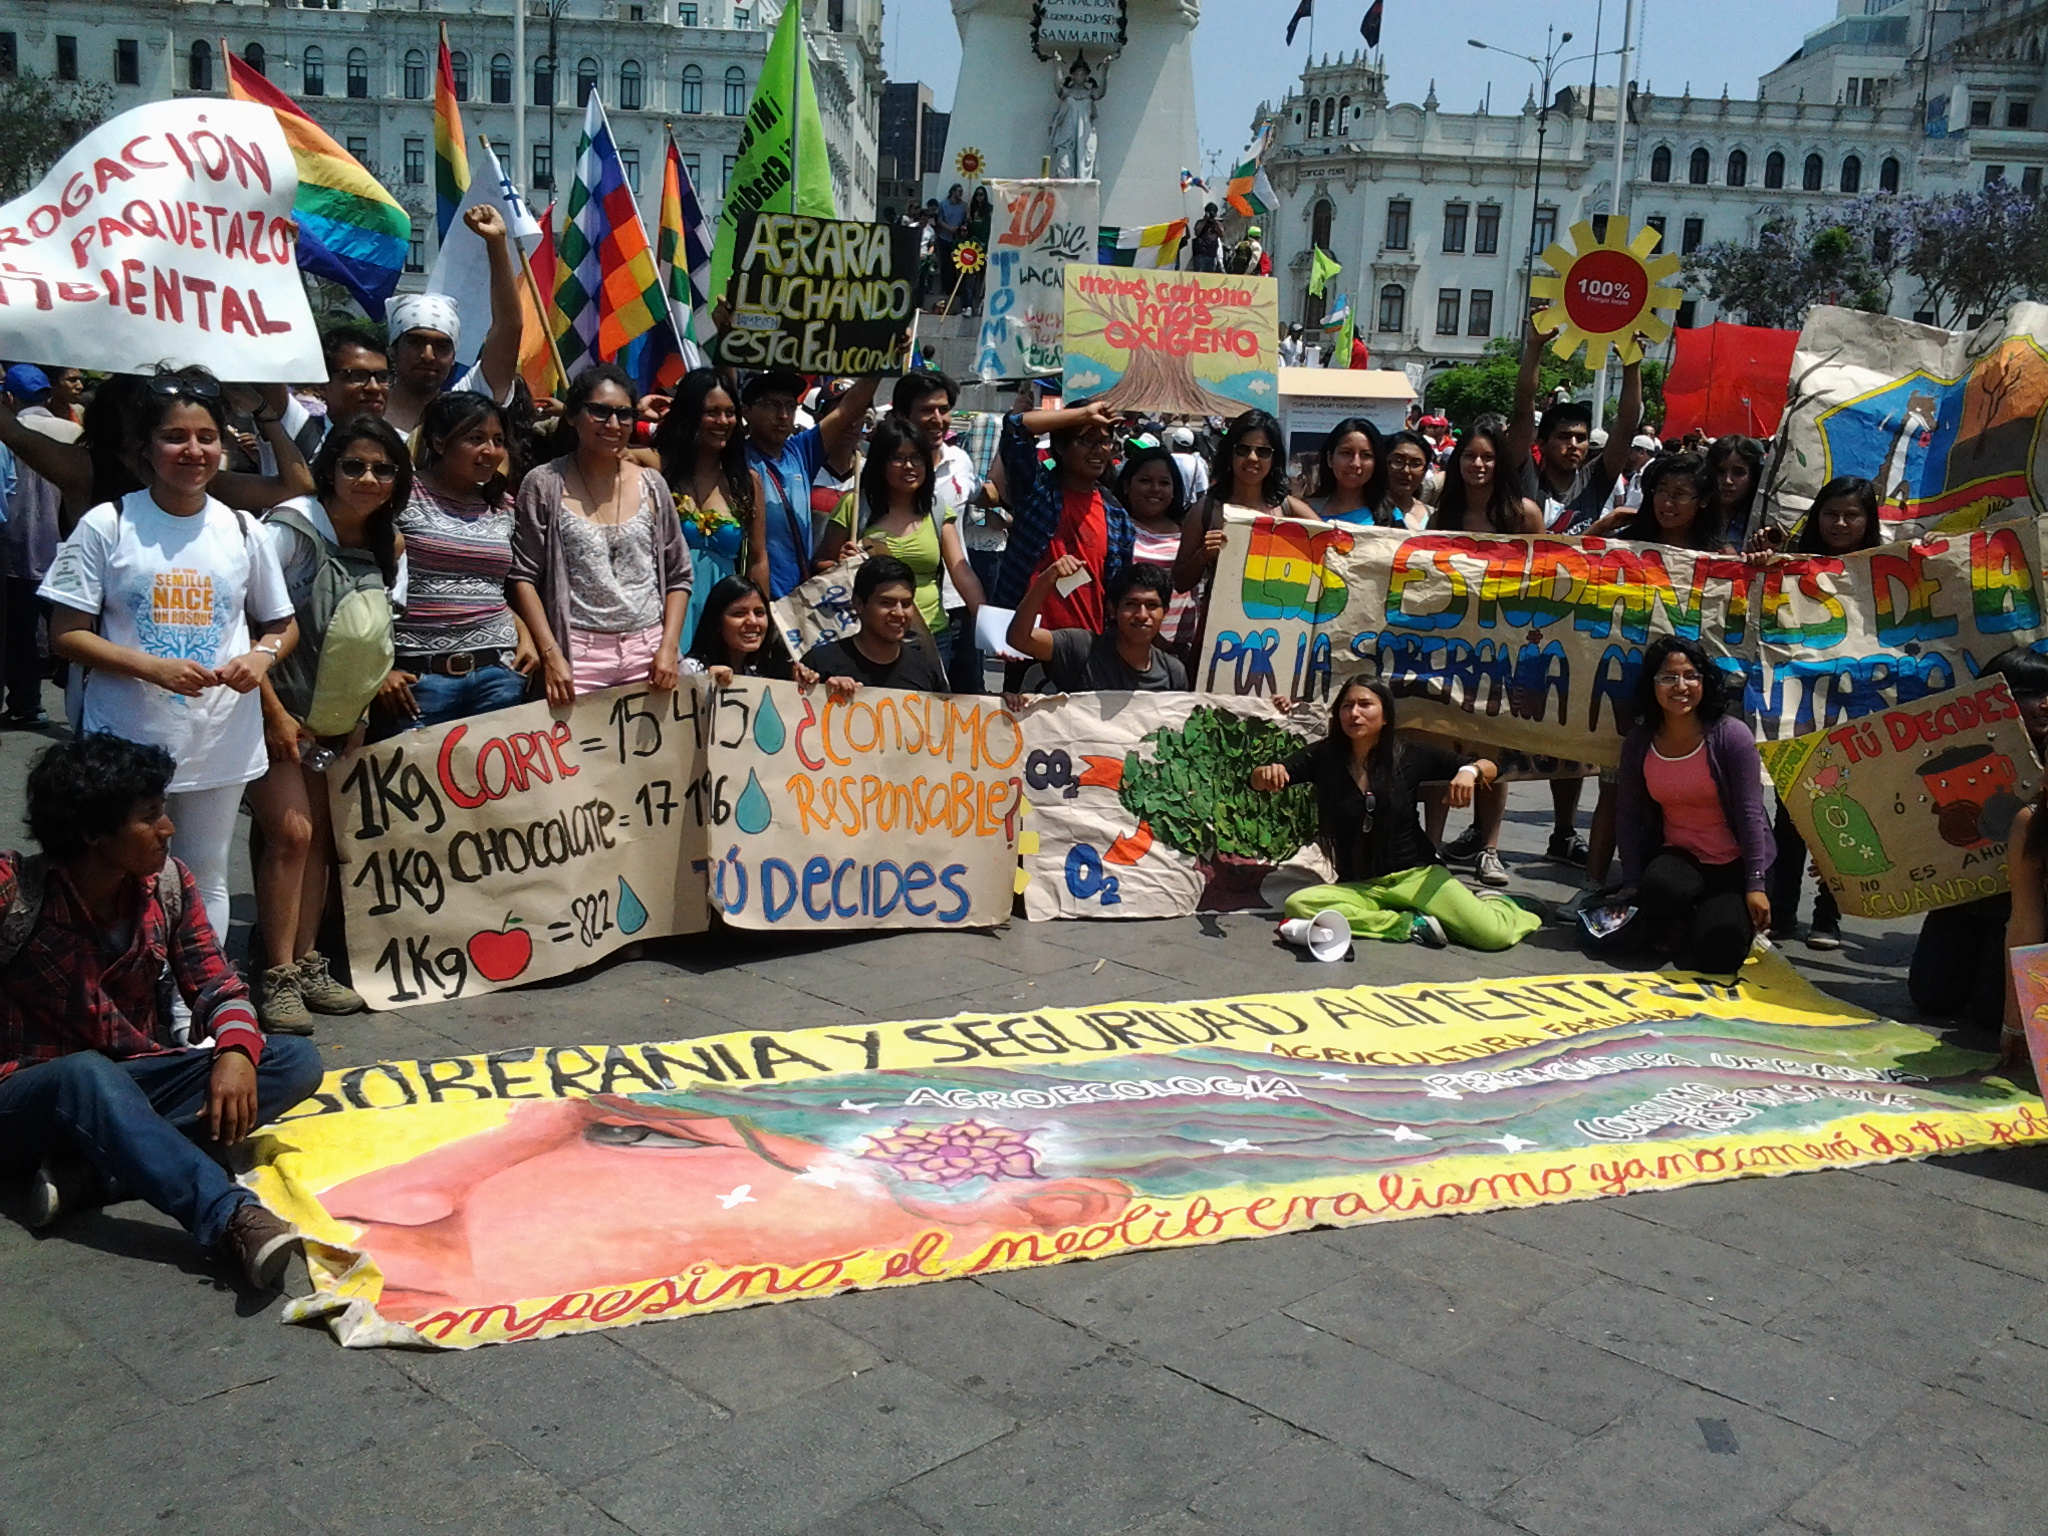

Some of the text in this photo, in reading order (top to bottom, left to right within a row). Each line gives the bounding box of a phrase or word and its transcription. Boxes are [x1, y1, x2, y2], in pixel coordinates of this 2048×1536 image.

[71, 199, 292, 269] PAQUETAZO
[998, 191, 1055, 247] 10
[733, 273, 912, 322] LUCHANDO
[1079, 275, 1252, 306] menos carbono
[1578, 278, 1631, 299] 100%
[1103, 320, 1258, 357] OXIGENO
[153, 586, 214, 612] NACE
[154, 573, 213, 588] SEMILLA
[1242, 517, 1355, 624] LOS
[1870, 539, 1959, 648] DE
[1206, 628, 1281, 698] POR
[1827, 682, 2021, 764] TÚ DECIDES
[1860, 878, 1880, 892] NO
[1909, 863, 1937, 882] ES
[824, 1031, 880, 1069] Y
[903, 1002, 1308, 1063] SEGURIDAD
[1270, 1009, 1691, 1065] AGRICULTURA FAMILIAR
[905, 1075, 1303, 1108] AGROECOLOGIA
[877, 1231, 947, 1283] el
[964, 1164, 1577, 1274] neoliberalismo
